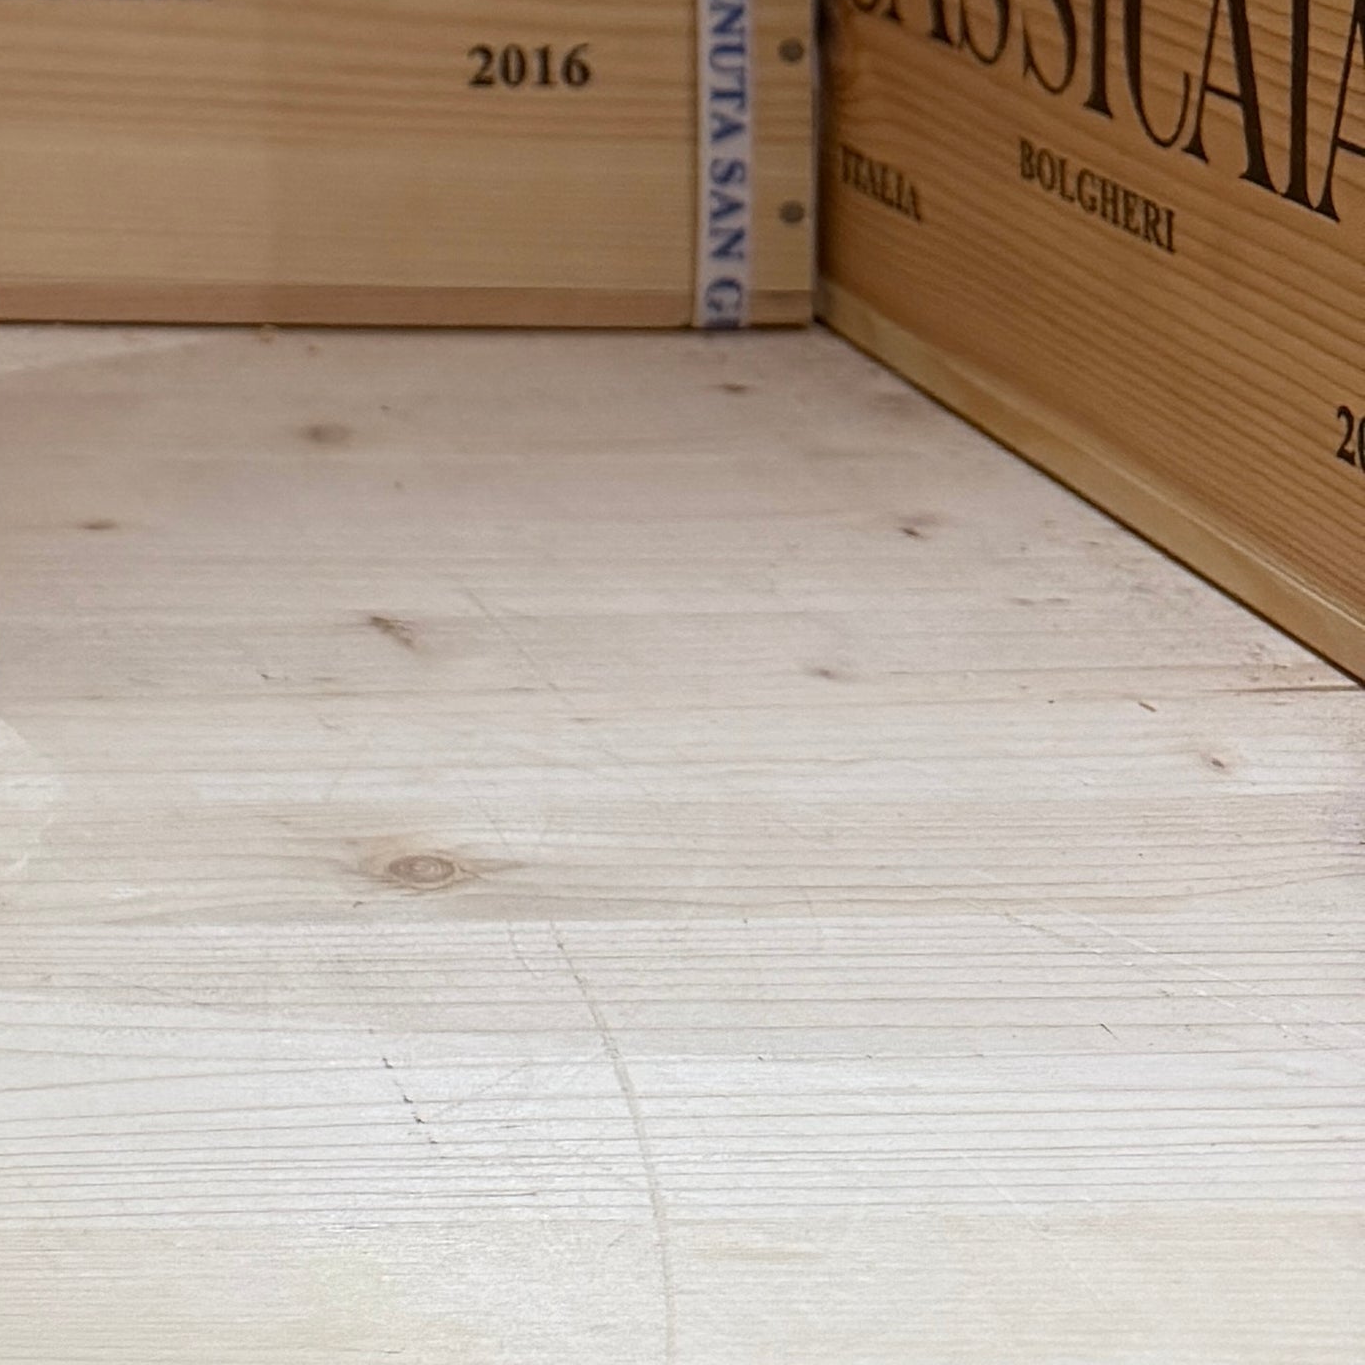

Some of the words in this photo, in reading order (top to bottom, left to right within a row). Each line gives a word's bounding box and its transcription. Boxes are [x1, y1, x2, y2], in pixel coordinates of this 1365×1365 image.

[467, 43, 592, 89] 2016
[707, 159, 747, 261] SAN
[840, 142, 923, 224] ITALIA
[1019, 136, 1177, 255] BOLGHERI
